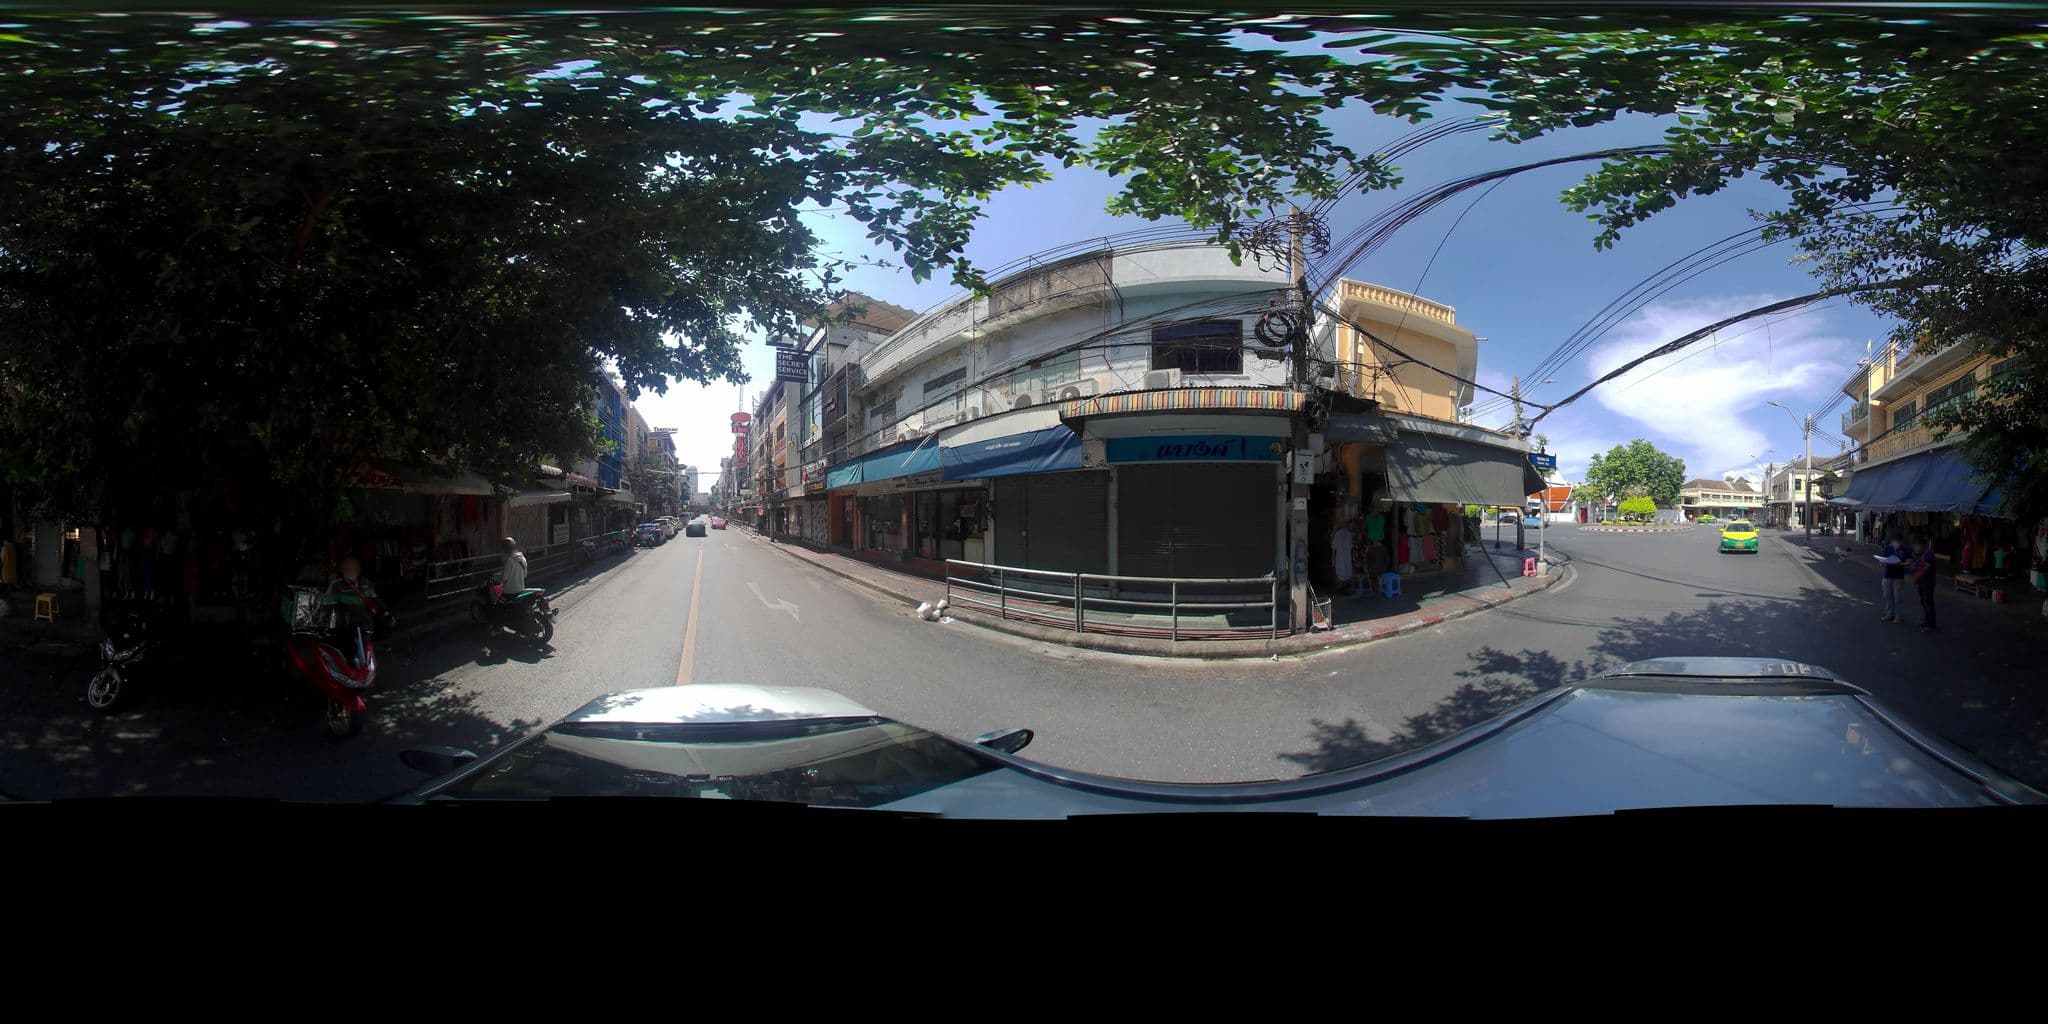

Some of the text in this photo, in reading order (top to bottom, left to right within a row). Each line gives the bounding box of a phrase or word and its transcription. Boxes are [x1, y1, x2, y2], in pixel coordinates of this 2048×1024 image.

[777, 353, 793, 361] THE
[777, 359, 804, 369] SECRET
[777, 366, 808, 376] SERVICE
